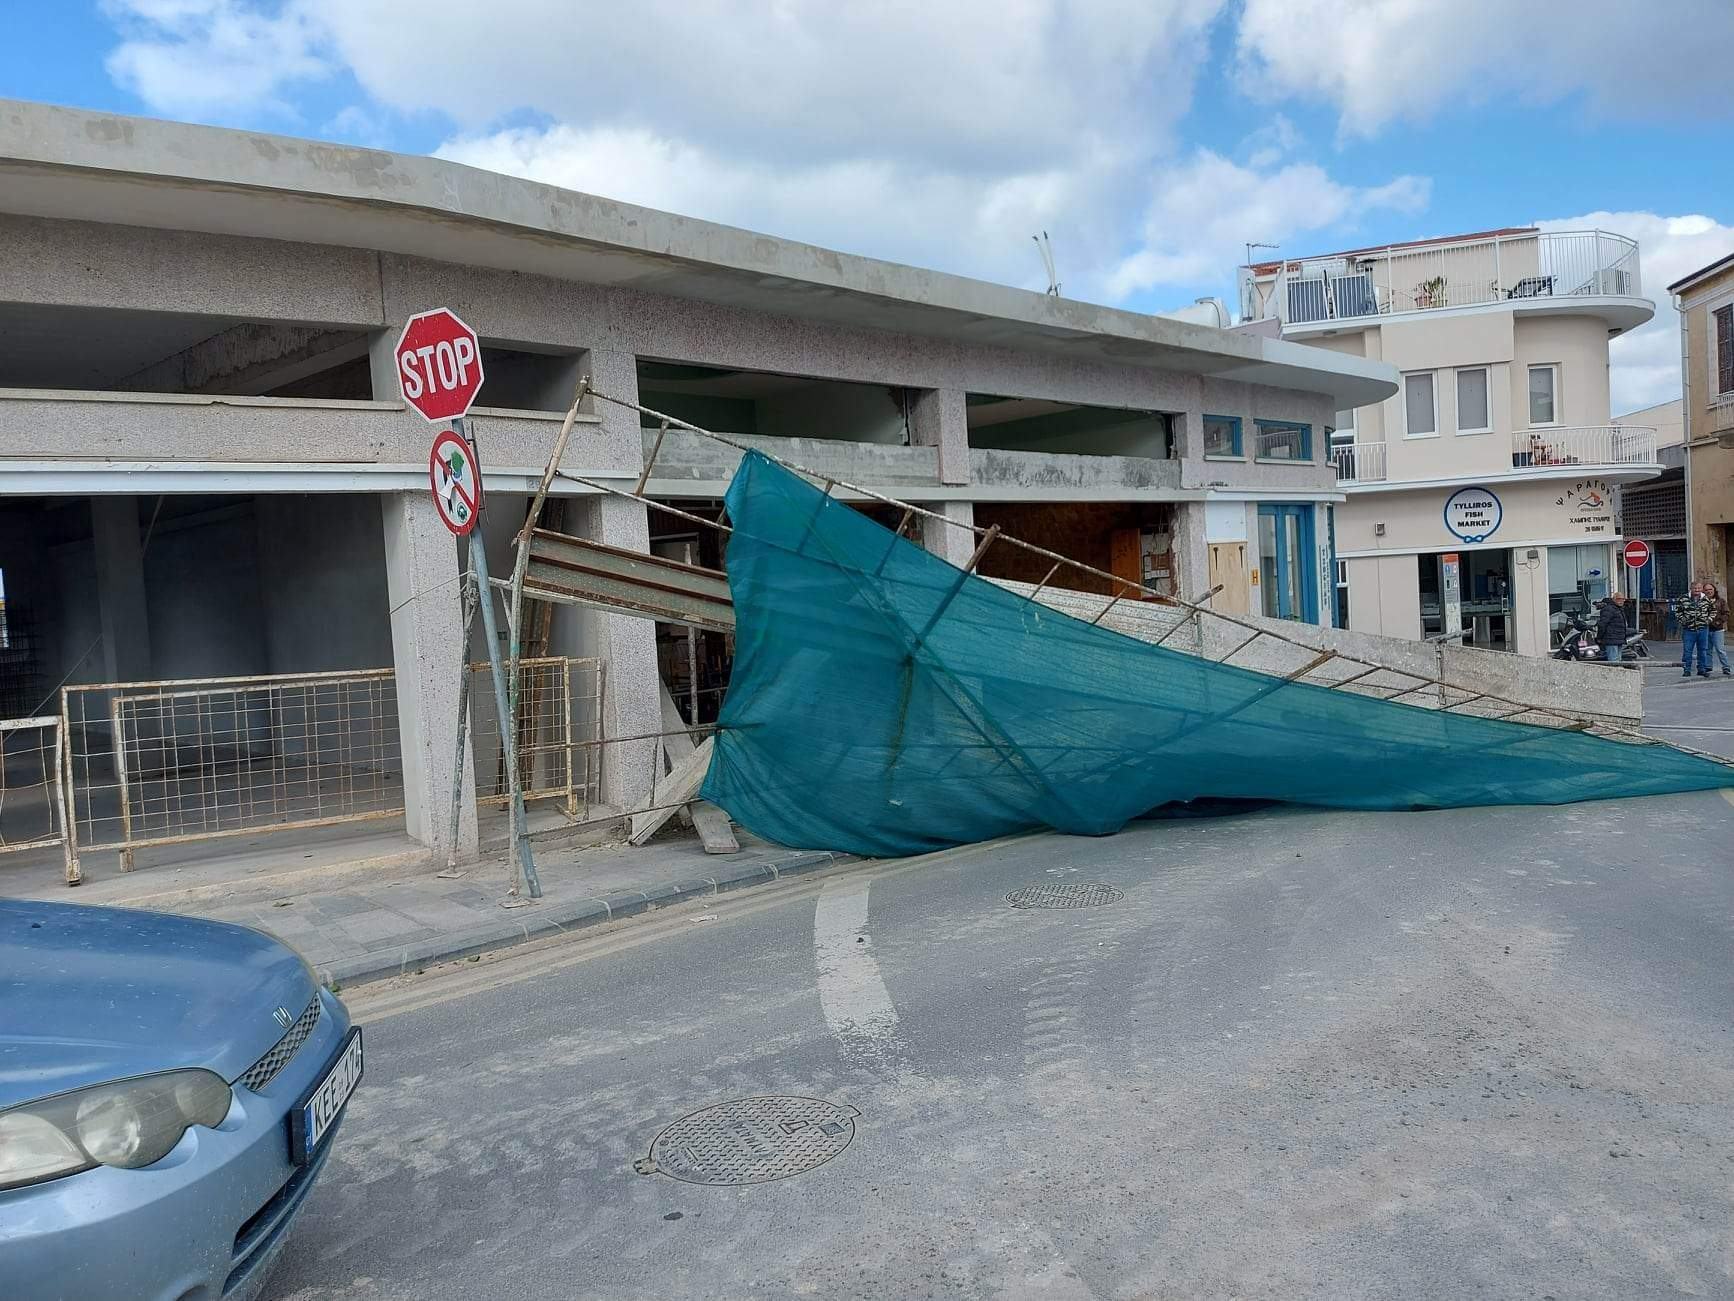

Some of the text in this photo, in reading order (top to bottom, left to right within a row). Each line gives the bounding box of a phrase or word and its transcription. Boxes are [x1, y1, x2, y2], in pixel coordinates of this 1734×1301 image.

[401, 337, 474, 398] STOP
[1454, 501, 1493, 510] TYLLIROS
[1458, 520, 1491, 528] MARKET
[315, 1075, 339, 1137] KEE
